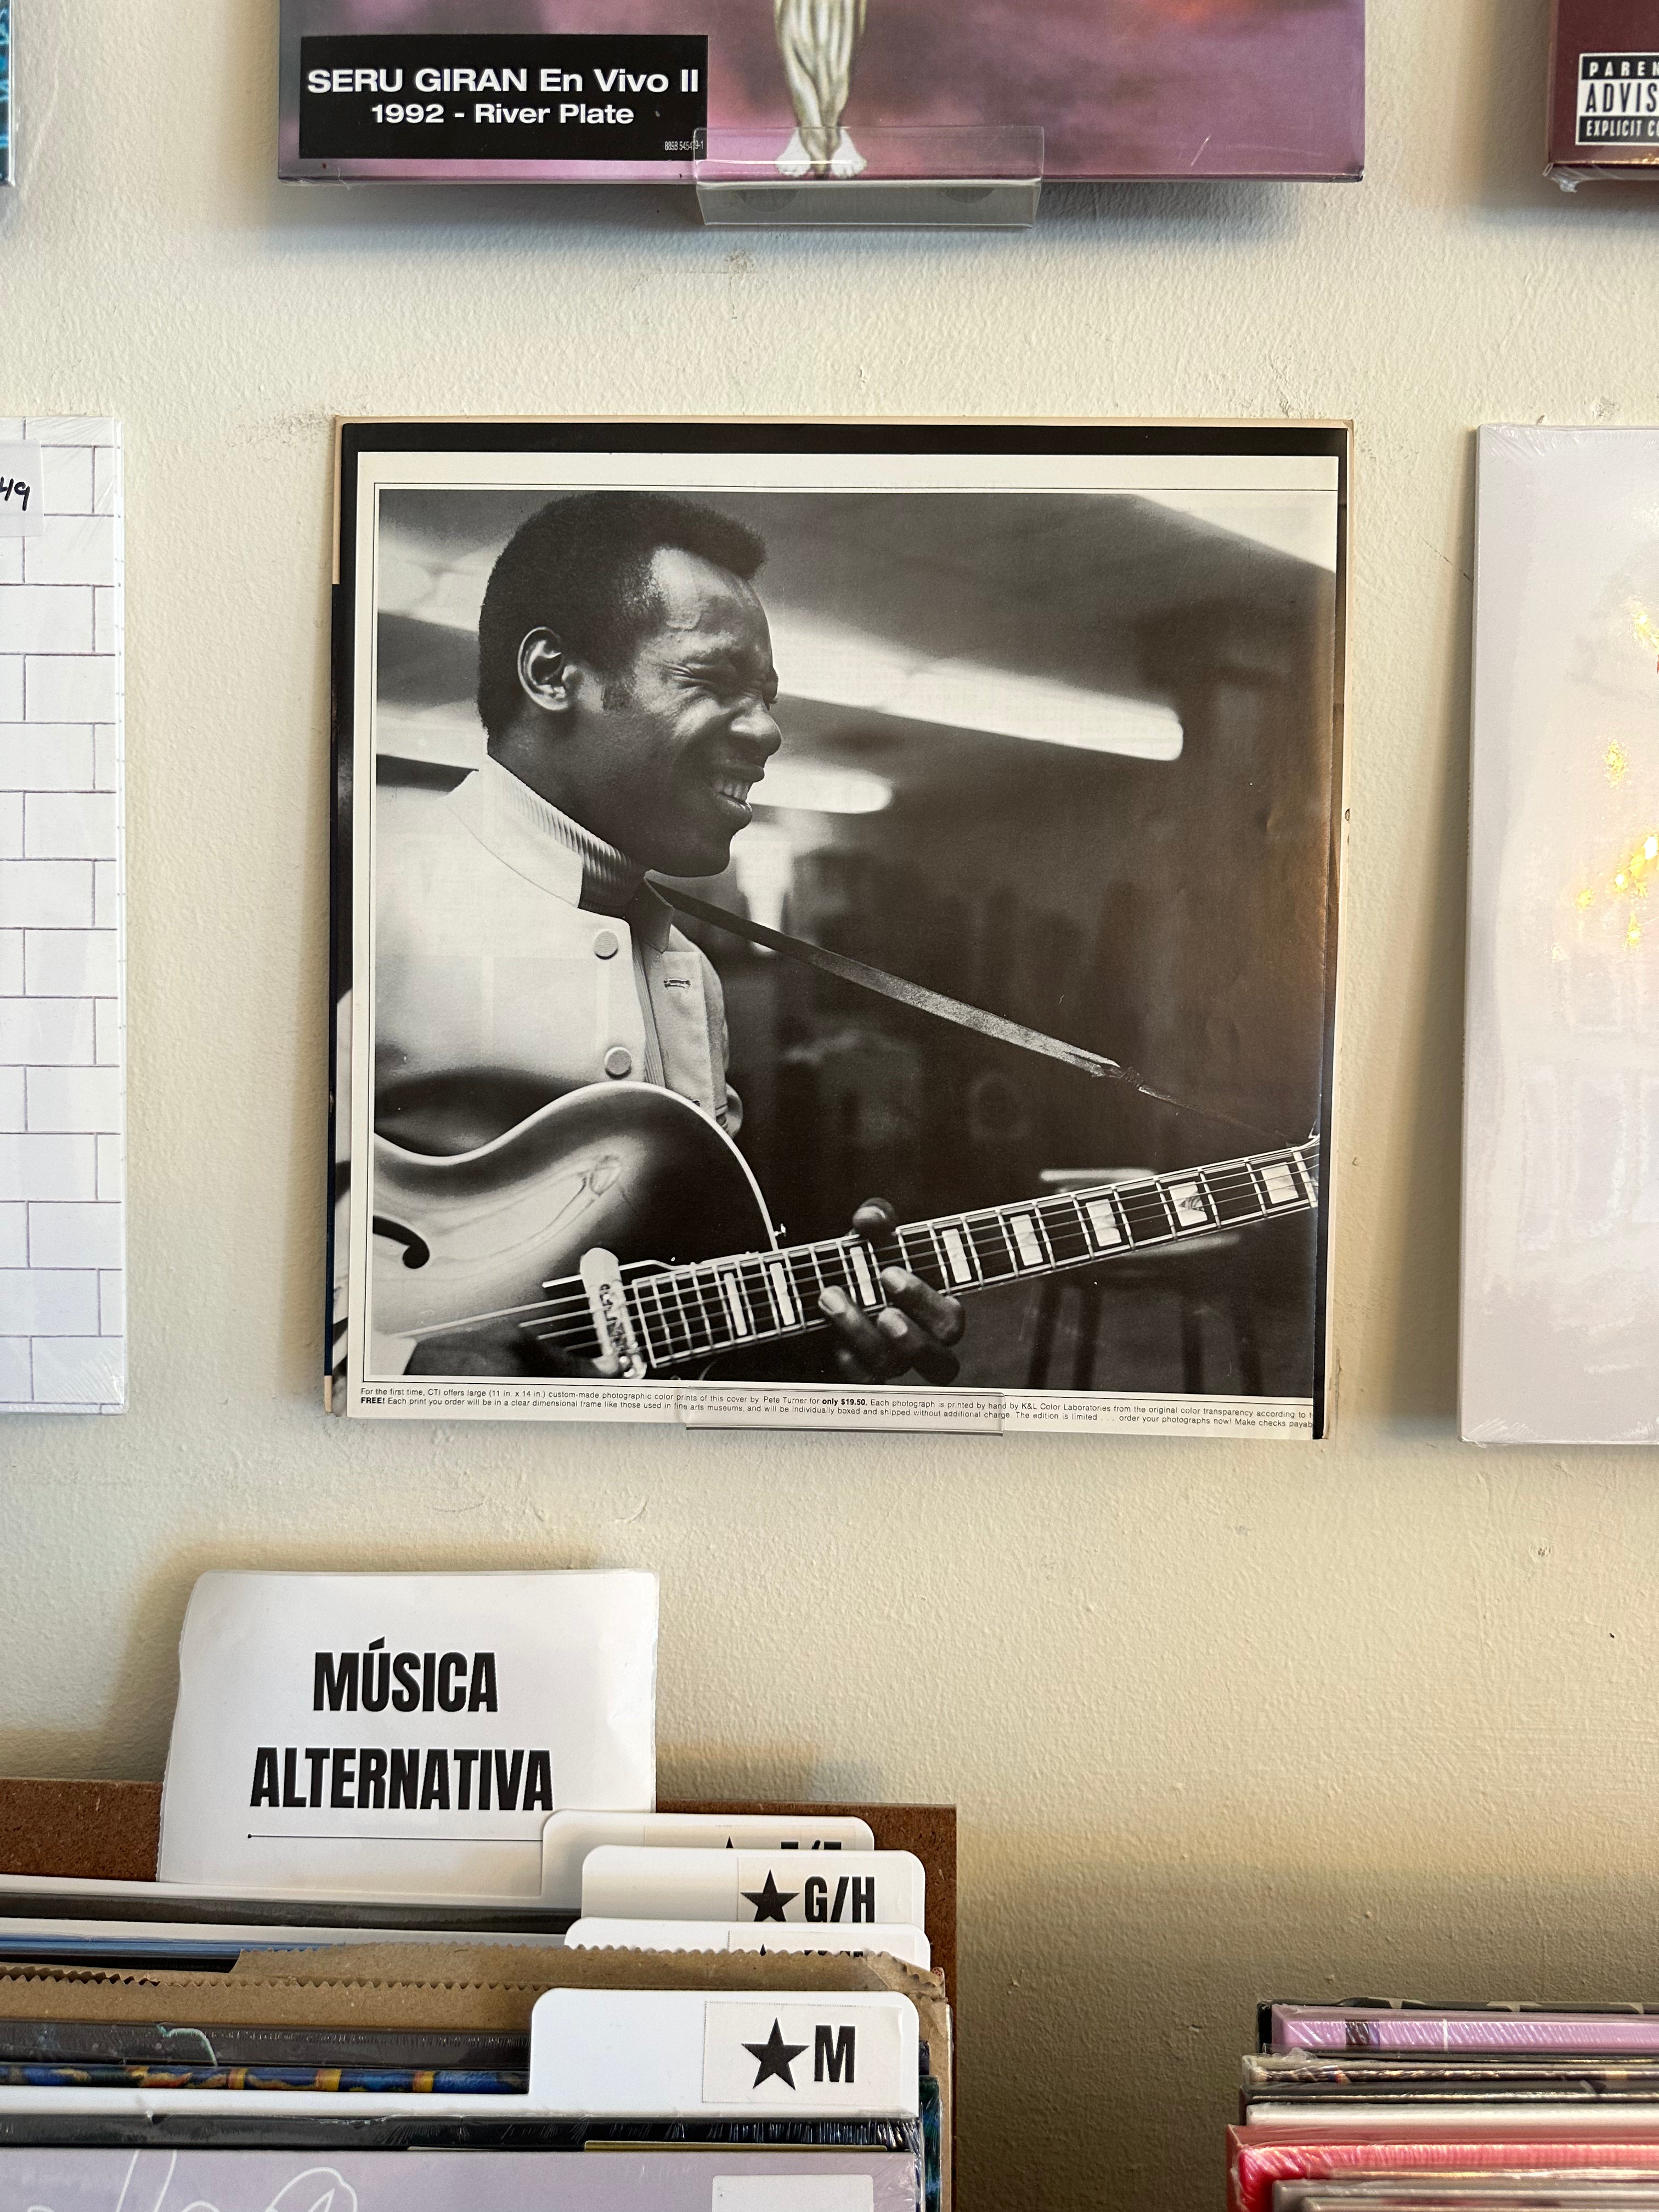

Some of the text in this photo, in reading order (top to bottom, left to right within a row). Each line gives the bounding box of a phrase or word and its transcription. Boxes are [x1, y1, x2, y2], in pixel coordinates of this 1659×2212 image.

[308, 68, 699, 93] SERU GIRAN En Vivo II
[1585, 82, 1657, 112] ADVIS
[371, 104, 444, 123] 1992
[475, 103, 550, 123] River
[560, 104, 634, 124] Plate
[1586, 119, 1642, 137] EXPLICIT
[664, 141, 678, 151] 8898
[407, 1389, 425, 1397] time,
[466, 1390, 486, 1398] large
[489, 1390, 500, 1398] (11
[548, 1391, 600, 1399] custom-made
[602, 1392, 652, 1401] photographic
[676, 1393, 698, 1402] prints
[750, 1395, 759, 1403] by
[822, 1397, 839, 1406] only
[891, 1399, 935, 1408] photograph
[947, 1400, 974, 1409] printed
[976, 1401, 986, 1409] by
[1009, 1402, 1019, 1410] by
[1063, 1403, 1111, 1412] Laboratories
[1148, 1406, 1178, 1415] original
[1203, 1408, 1254, 1417] transparency
[1256, 1409, 1295, 1419] according
[409, 1397, 427, 1406] print
[532, 1399, 578, 1407] dimensional
[792, 1406, 834, 1414] individually
[880, 1408, 911, 1417] shipped
[1161, 1415, 1211, 1425] photographs
[313, 1637, 498, 1712] MÚSICA
[250, 1747, 554, 1811] ALTERNATIVA
[805, 1876, 875, 1923] G/H
[814, 2025, 856, 2084] M
